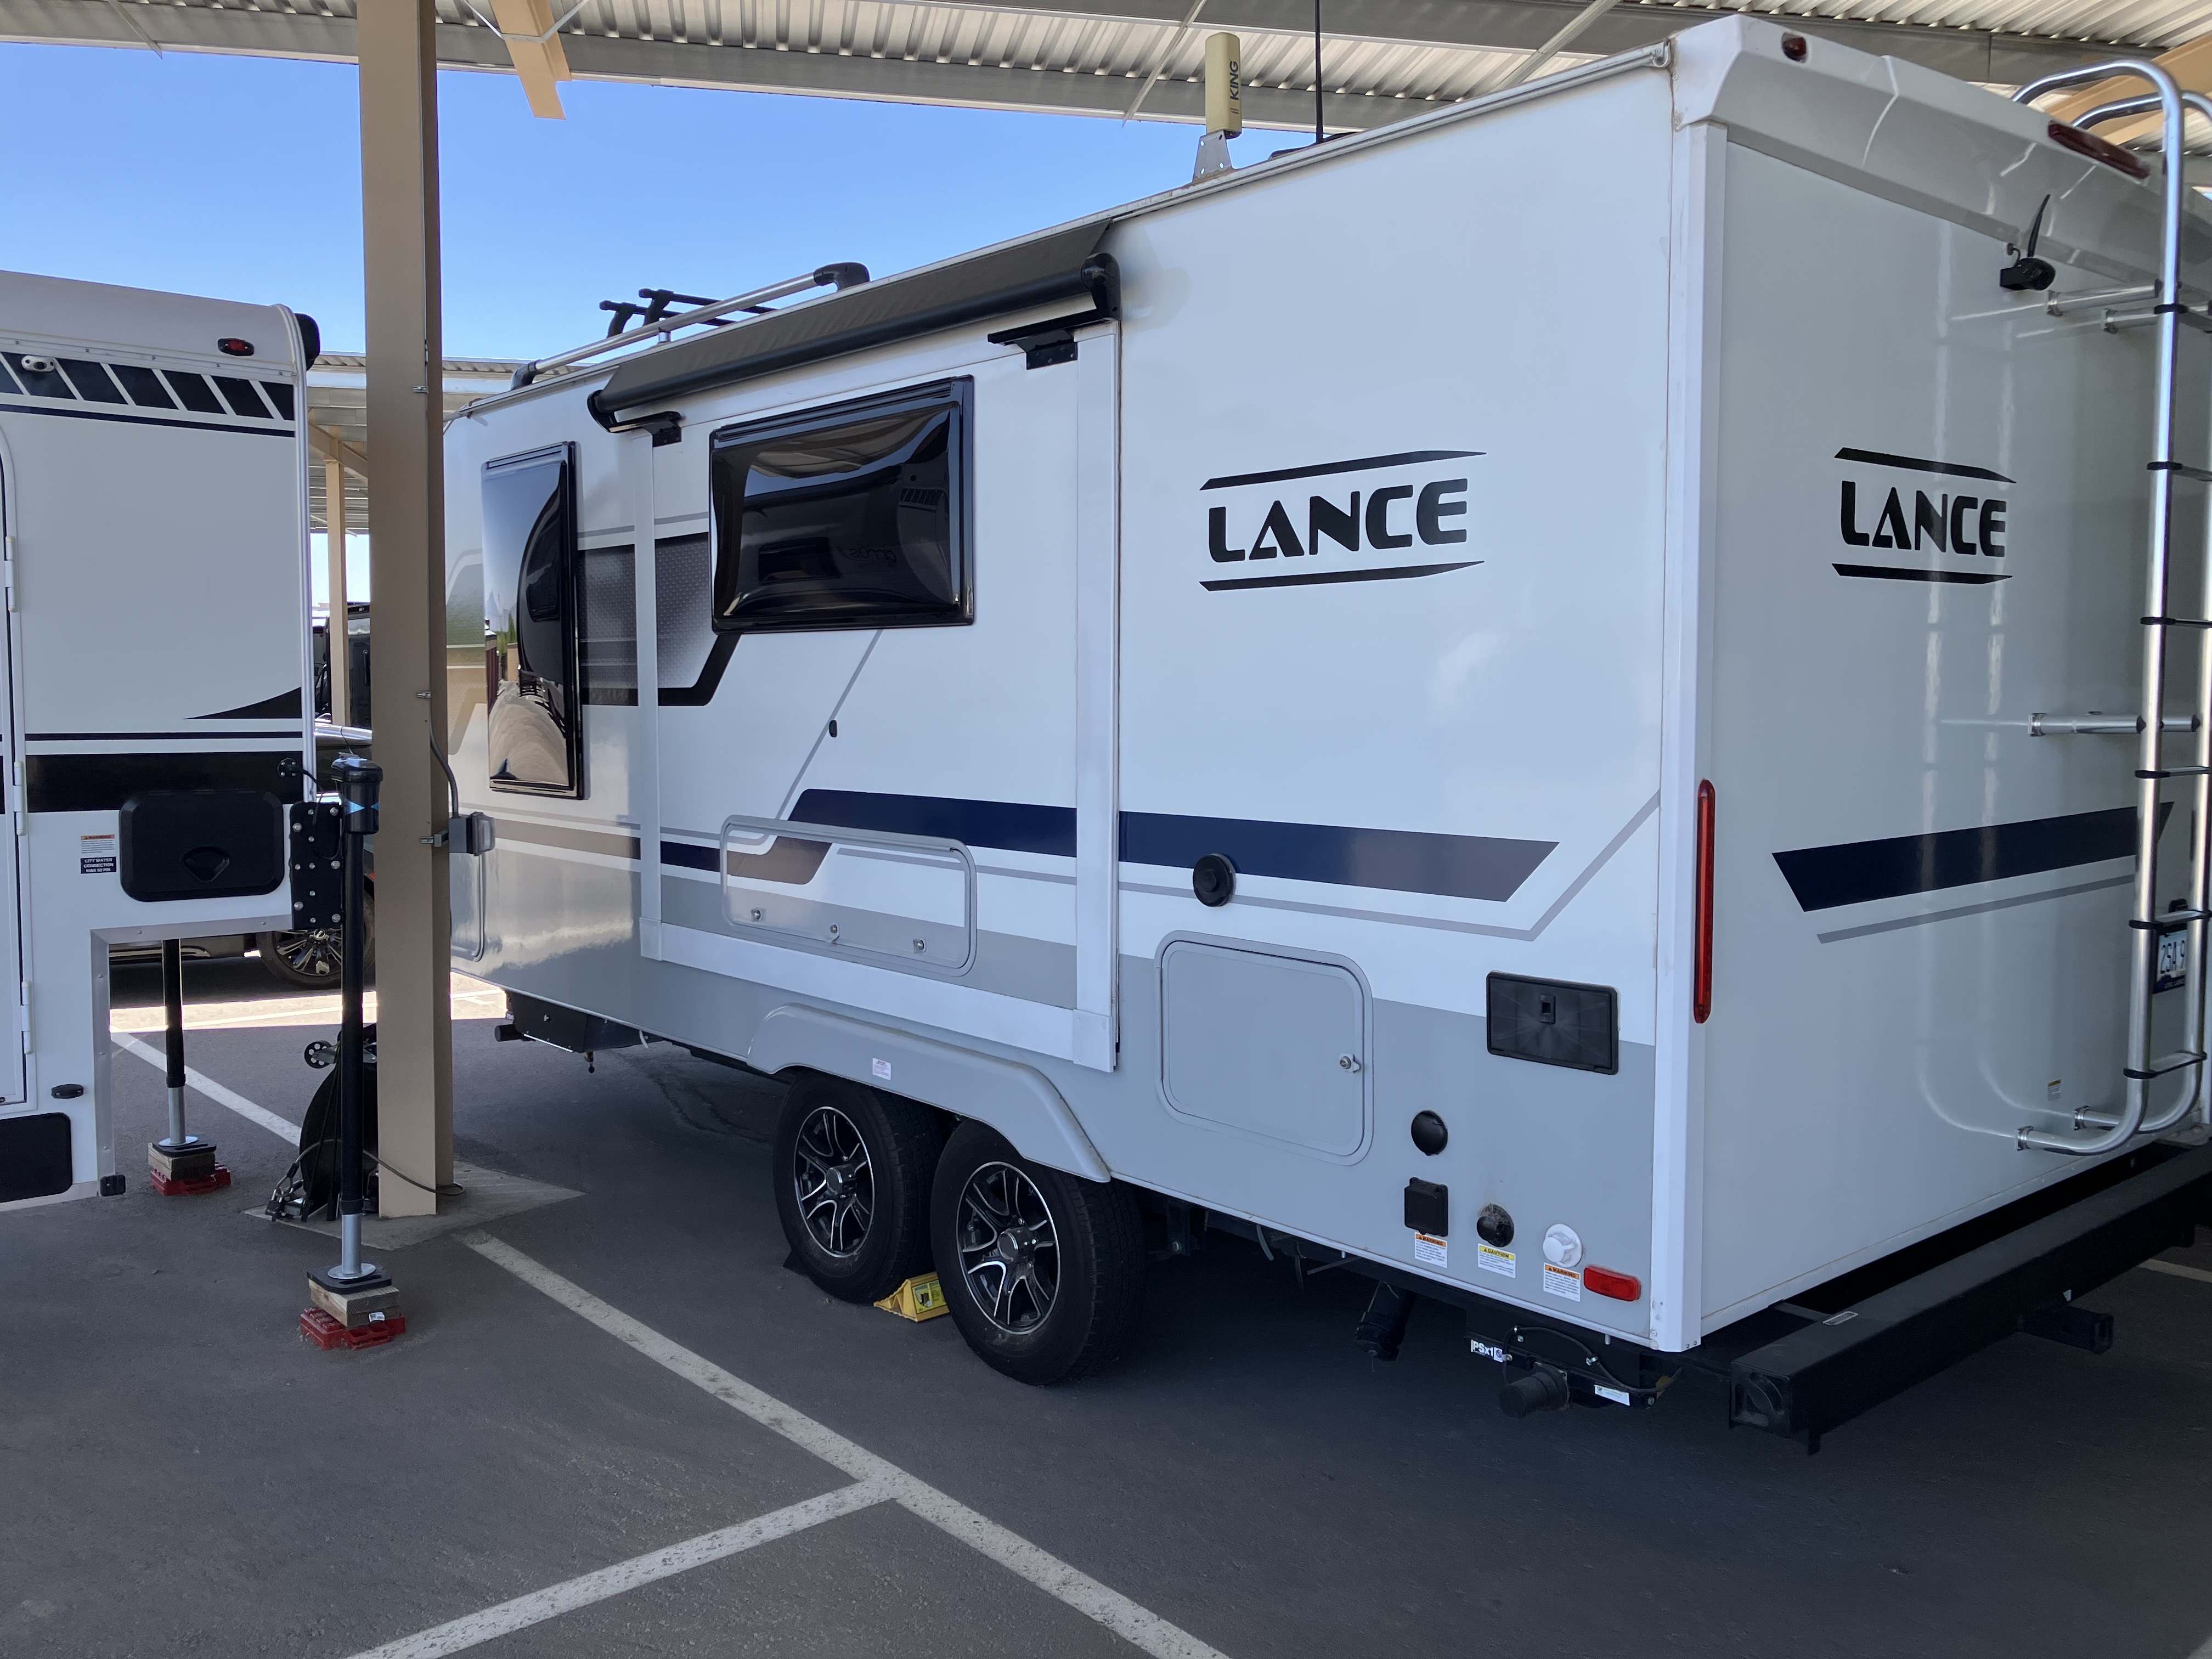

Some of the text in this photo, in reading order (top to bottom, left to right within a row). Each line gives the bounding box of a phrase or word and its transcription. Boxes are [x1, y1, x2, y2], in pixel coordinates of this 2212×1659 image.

[1229, 60, 1239, 100] KING
[1209, 478, 1468, 563] LANCE
[1841, 481, 2006, 557] LANCE
[1487, 1249, 1509, 1258] CAUTION
